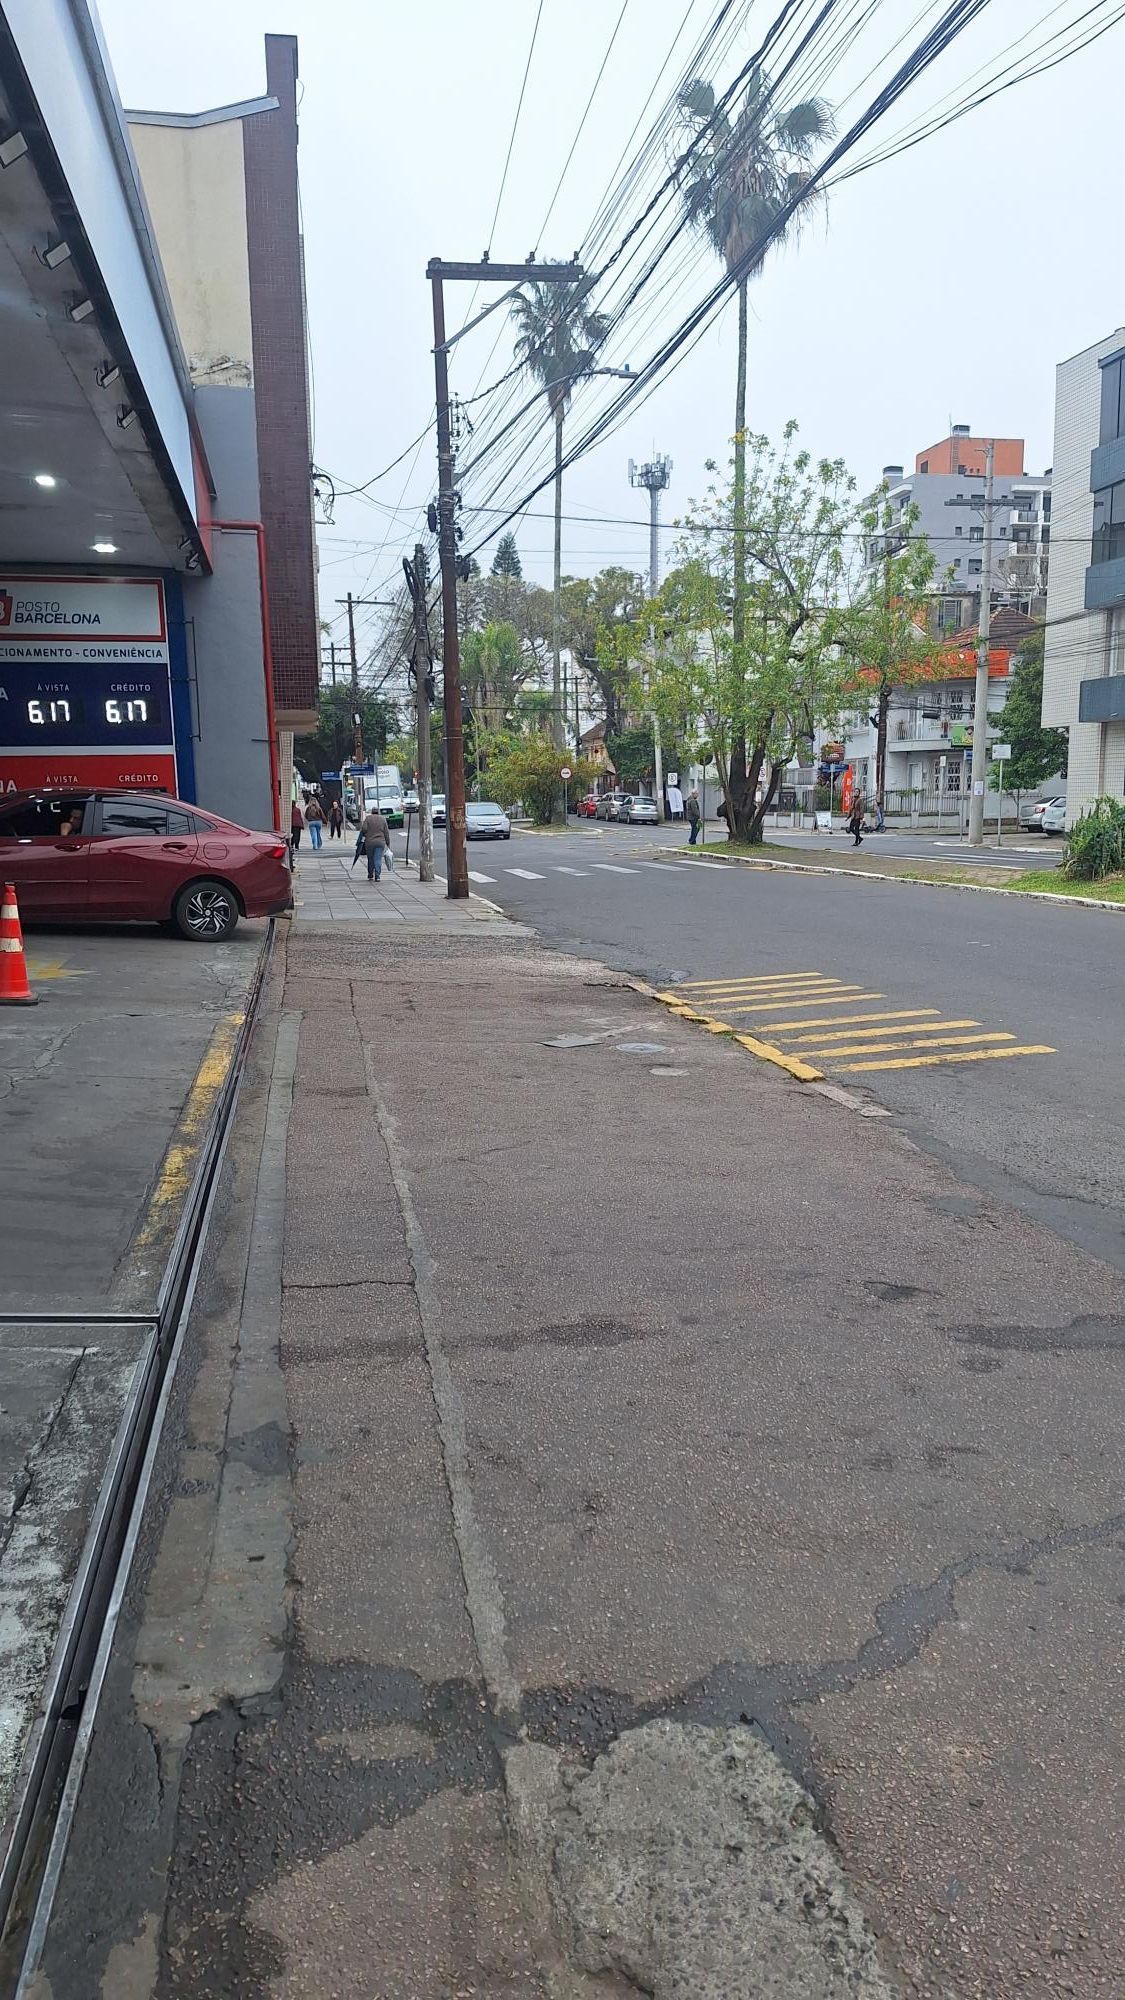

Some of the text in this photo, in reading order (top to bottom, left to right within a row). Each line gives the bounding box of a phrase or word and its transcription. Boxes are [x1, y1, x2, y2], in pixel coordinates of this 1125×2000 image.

[16, 601, 60, 613] POSTO
[14, 612, 101, 625] BARCELONA
[82, 646, 163, 658] CONVENIÊNCIA
[44, 683, 70, 692] VISTA
[110, 682, 151, 692] CRÉDITO
[53, 775, 78, 784] VISTA
[118, 773, 159, 783] CRÉDITO
